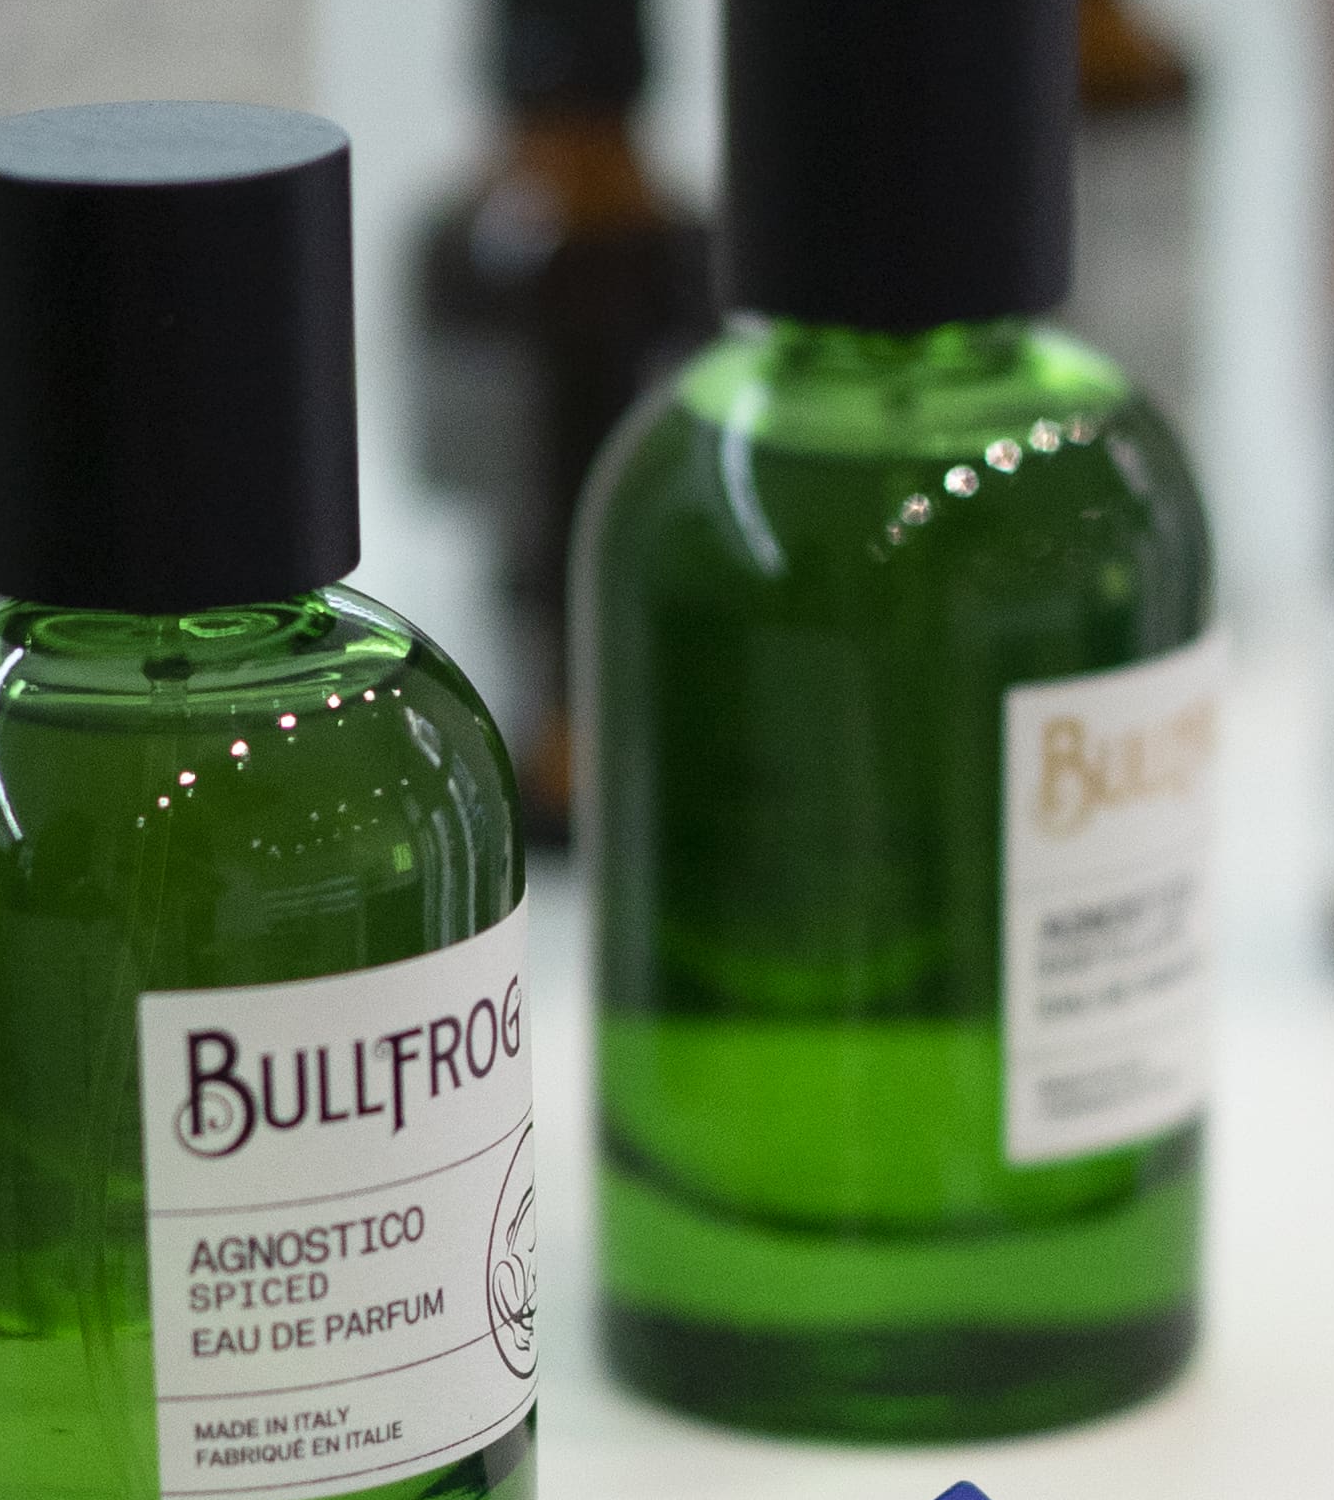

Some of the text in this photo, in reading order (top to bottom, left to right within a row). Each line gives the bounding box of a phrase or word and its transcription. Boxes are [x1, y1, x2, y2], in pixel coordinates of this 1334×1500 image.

[175, 973, 523, 1158] BULLFROG
[188, 1206, 425, 1277] AGNOSTICO
[189, 1272, 329, 1314] SPICED
[191, 1288, 445, 1358] EAU DE PARFUM
[194, 1406, 351, 1440] MADE IN ITALY
[195, 1420, 403, 1470] FABRIQUÉ EN ITALIE
